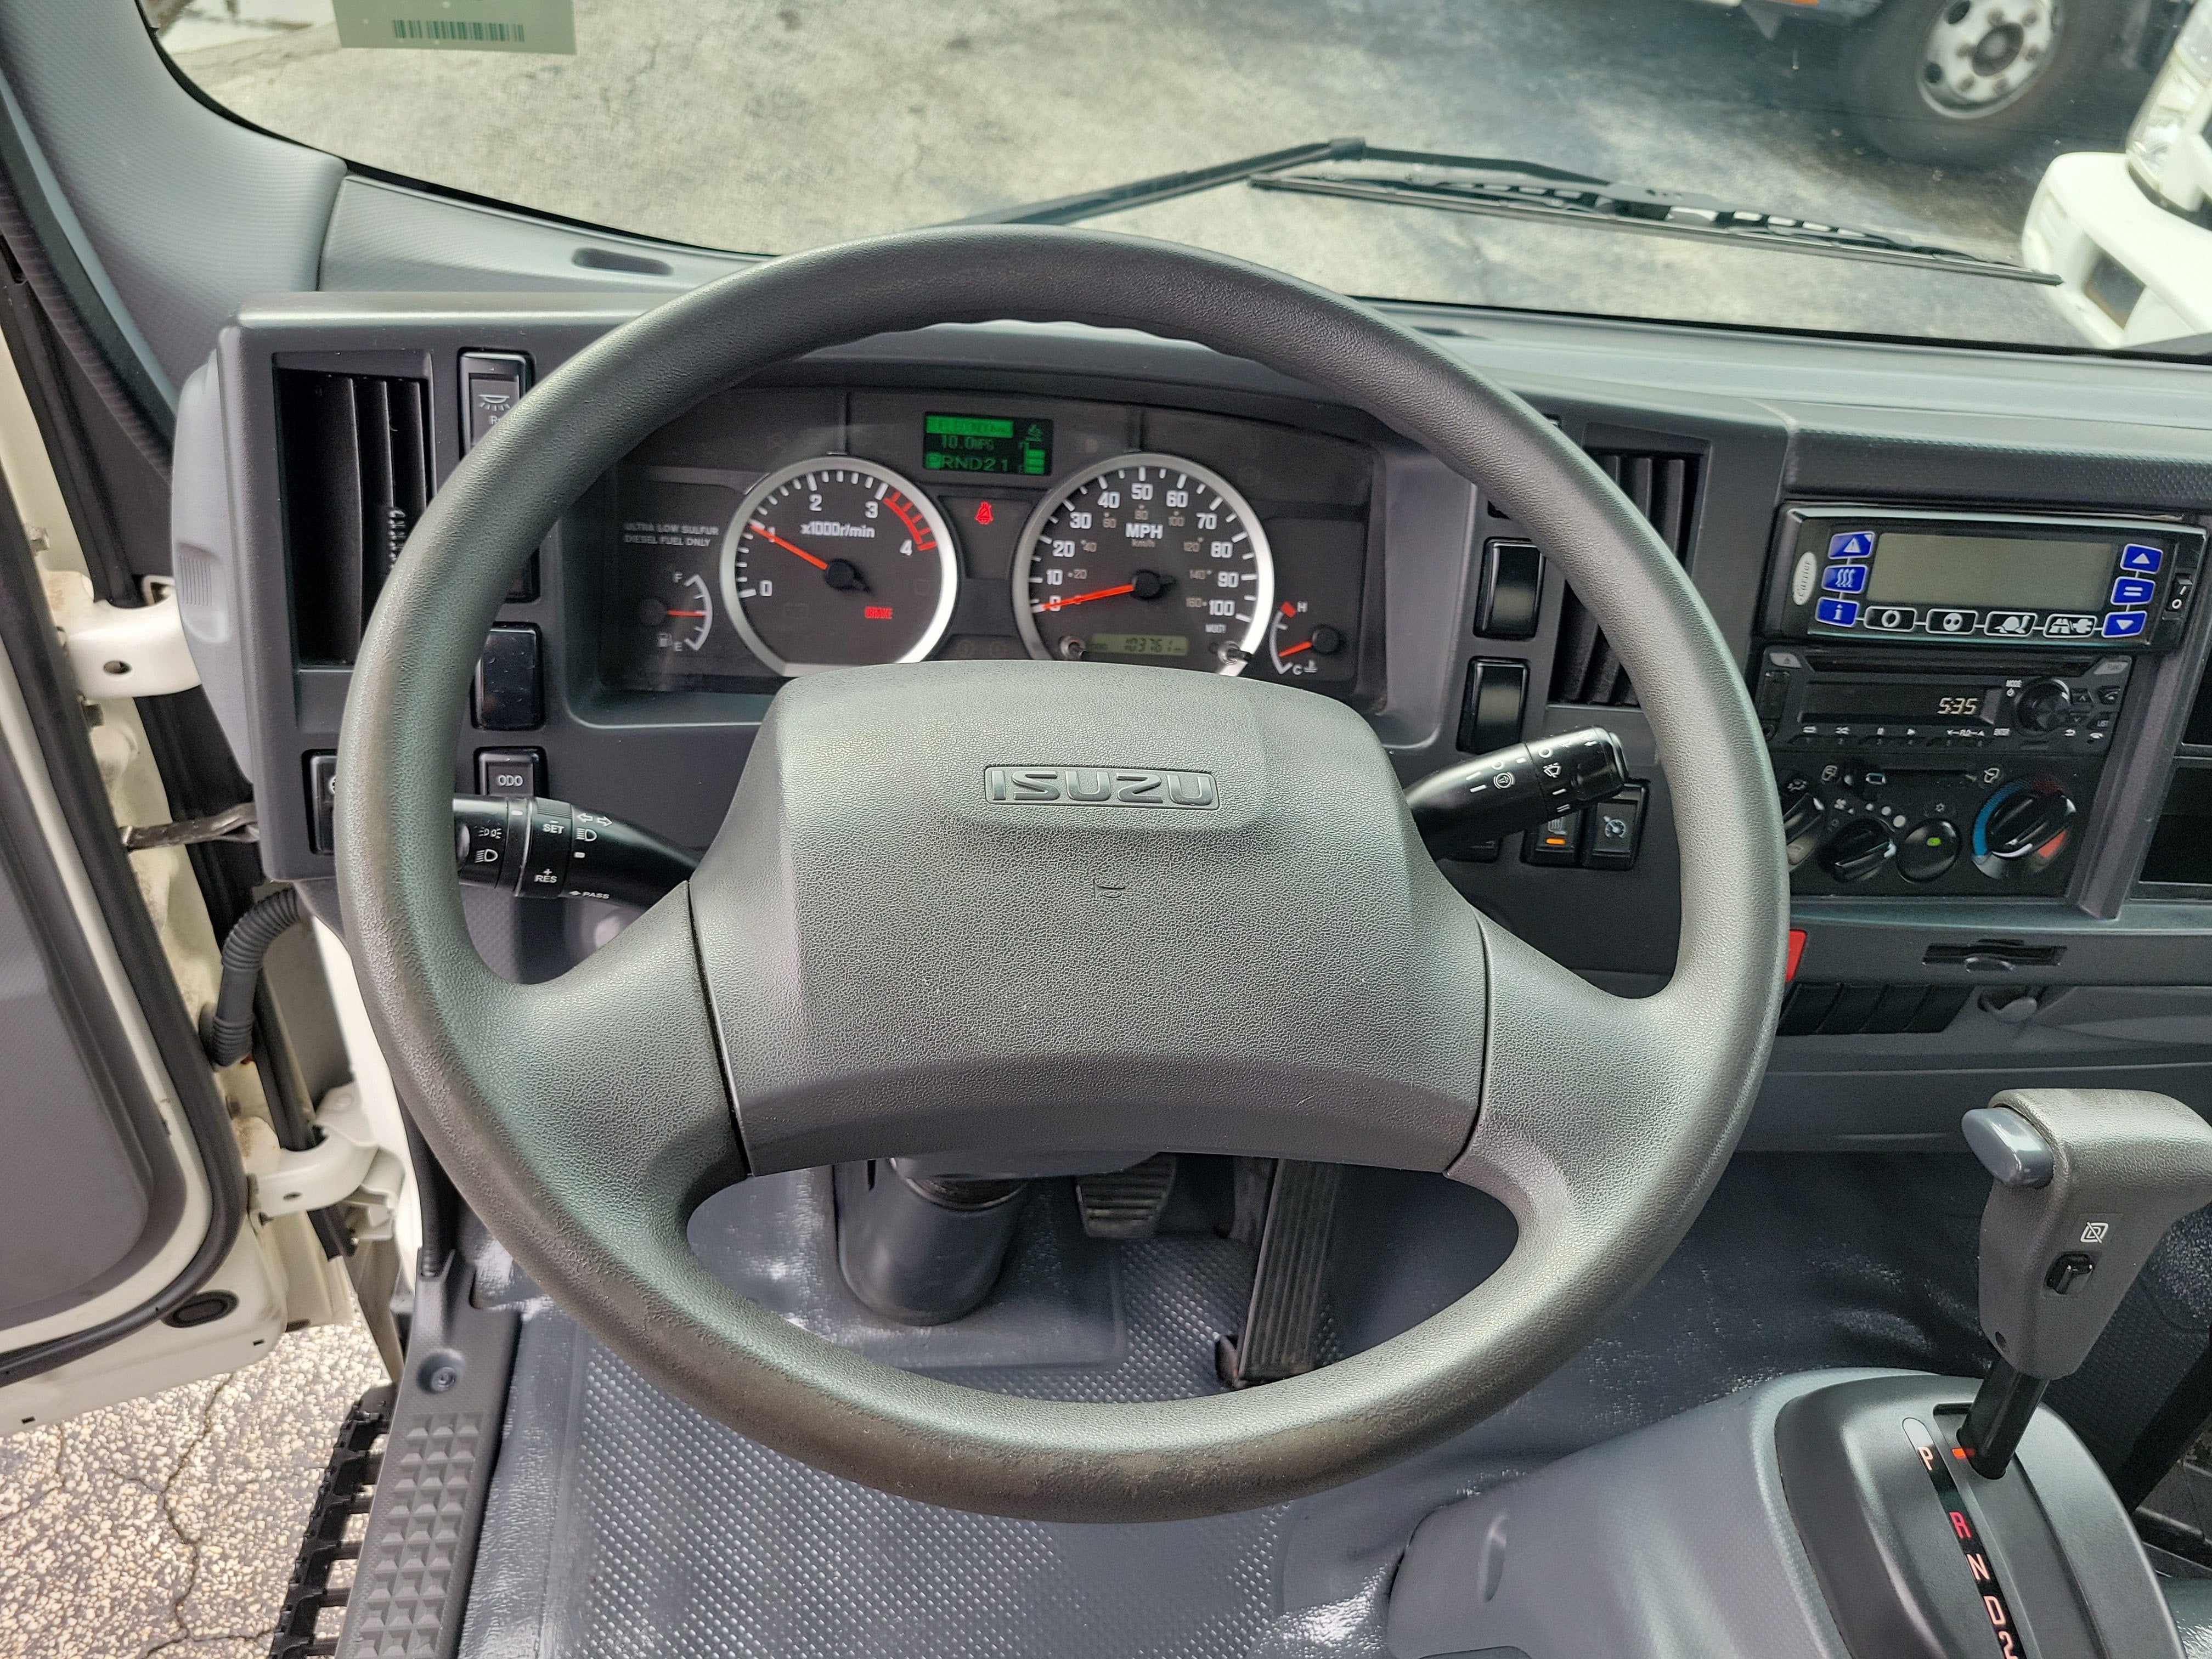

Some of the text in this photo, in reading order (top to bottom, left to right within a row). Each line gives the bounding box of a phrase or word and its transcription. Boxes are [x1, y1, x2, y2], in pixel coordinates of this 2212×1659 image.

[1097, 491, 1120, 509] 40
[1131, 483, 1153, 500] 50
[1166, 490, 1188, 508] 60
[809, 494, 822, 511] 2
[865, 501, 878, 518] 3
[657, 523, 680, 533] LOW
[1070, 511, 1092, 529] 30
[1196, 512, 1217, 529] 70
[800, 521, 875, 538] x1000r/min
[1126, 522, 1164, 539] MPH
[624, 534, 710, 547] DIESEL FUEL ONLY
[900, 539, 913, 556] 4
[1052, 539, 1075, 557] 20
[1210, 541, 1233, 558] 80
[673, 572, 683, 583] F
[1046, 568, 1063, 585] 10
[1217, 571, 1240, 588] 90
[760, 579, 773, 597] 0
[864, 606, 893, 619] BRAKE
[1209, 599, 1235, 617] 100
[1297, 601, 1307, 612] H
[674, 641, 683, 652] E
[1293, 664, 1303, 675] C
[497, 774, 523, 787] ODO
[991, 770, 1214, 806] ISUZU
[543, 823, 565, 834] SET
[534, 874, 557, 884] RES
[582, 891, 610, 900] PASS
[1918, 1446, 1934, 1470] P
[1949, 1511, 1972, 1539] R
[1966, 1554, 1990, 1580] N
[1983, 1595, 2006, 1625] D
